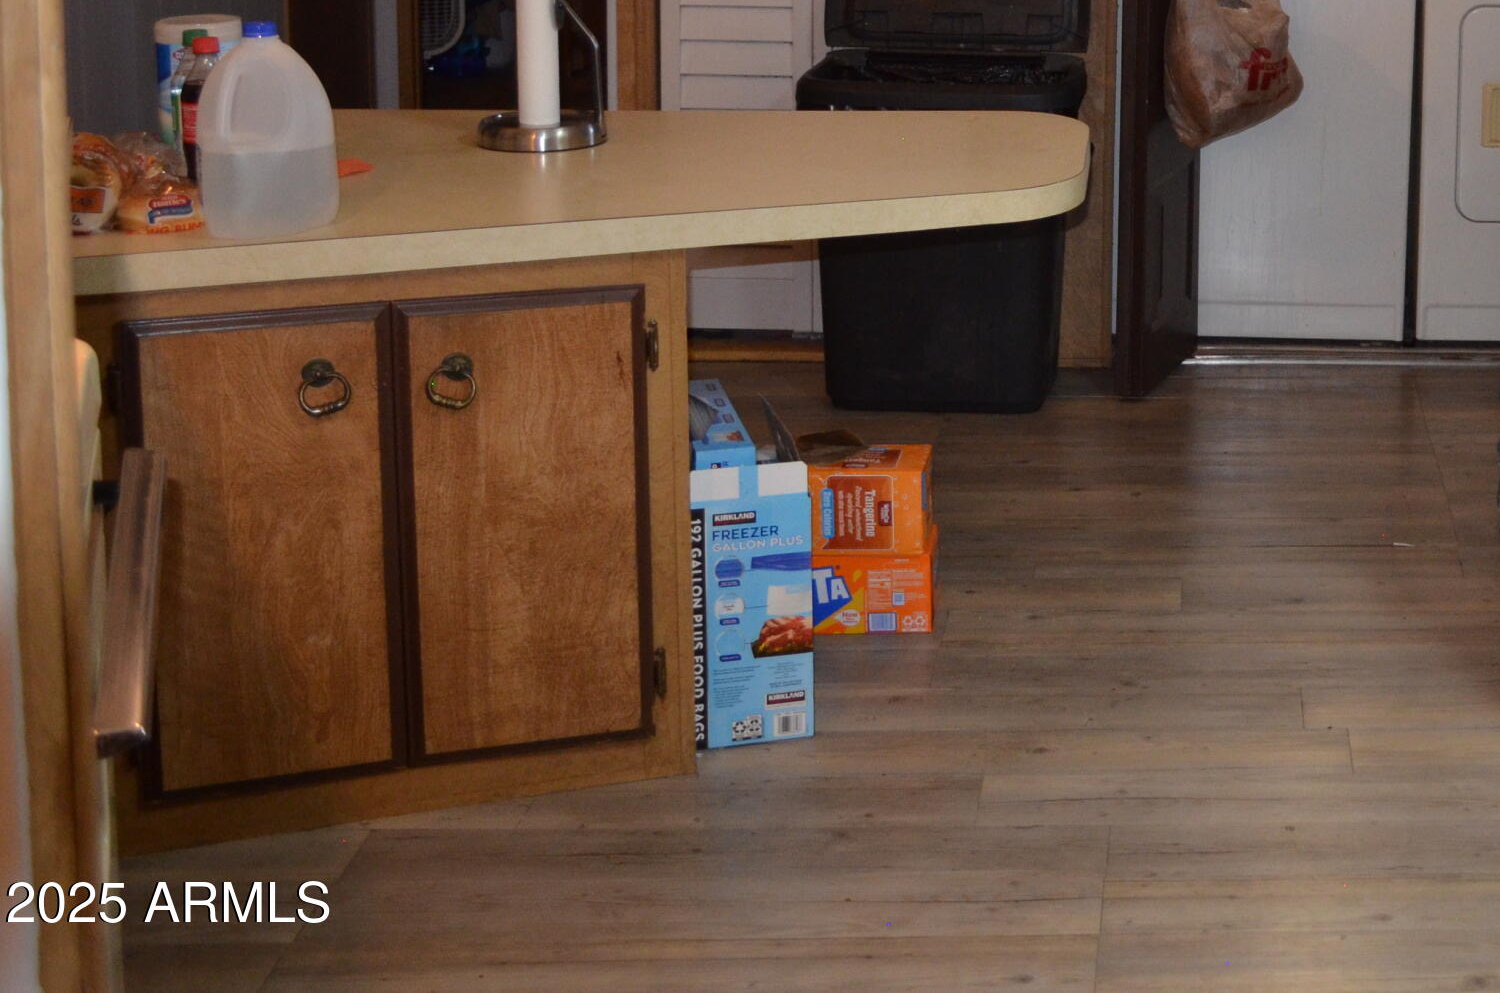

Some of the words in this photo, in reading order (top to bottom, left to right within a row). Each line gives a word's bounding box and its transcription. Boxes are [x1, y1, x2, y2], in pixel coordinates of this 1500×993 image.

[714, 511, 755, 522] KIRKLAND
[712, 525, 779, 542] FREEZER
[712, 538, 766, 553] GALLON
[770, 534, 804, 547] PLUS
[768, 690, 805, 702] KIRKLAND
